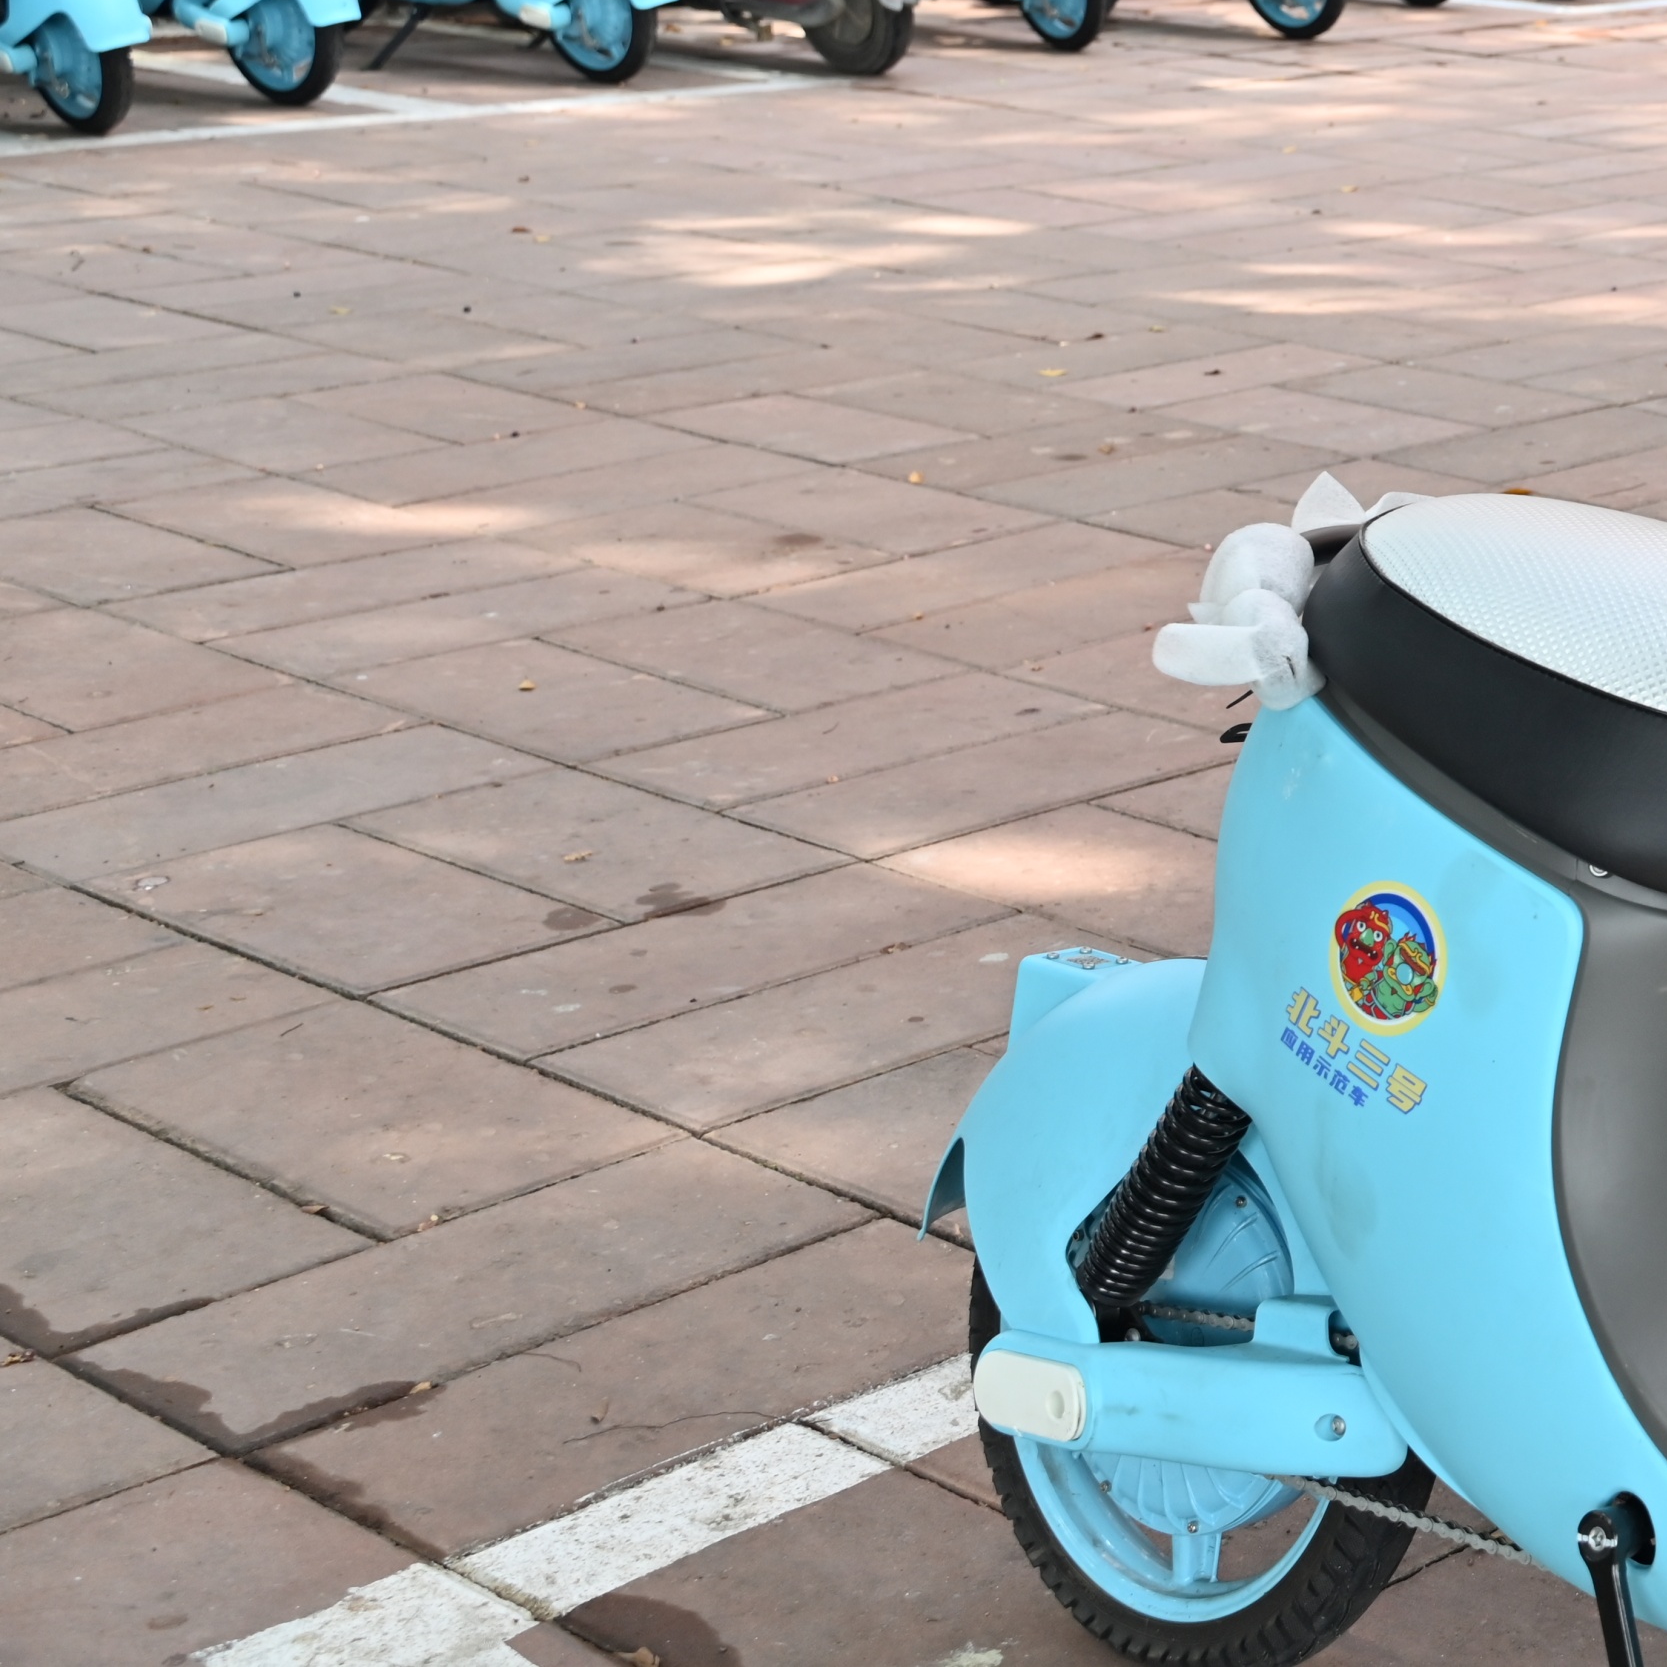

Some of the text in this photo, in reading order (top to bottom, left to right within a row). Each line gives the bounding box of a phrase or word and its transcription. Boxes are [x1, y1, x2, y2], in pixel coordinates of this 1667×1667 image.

[1280, 1026, 1369, 1107] 应用示范车
[1286, 986, 1428, 1115] 北斗三号
